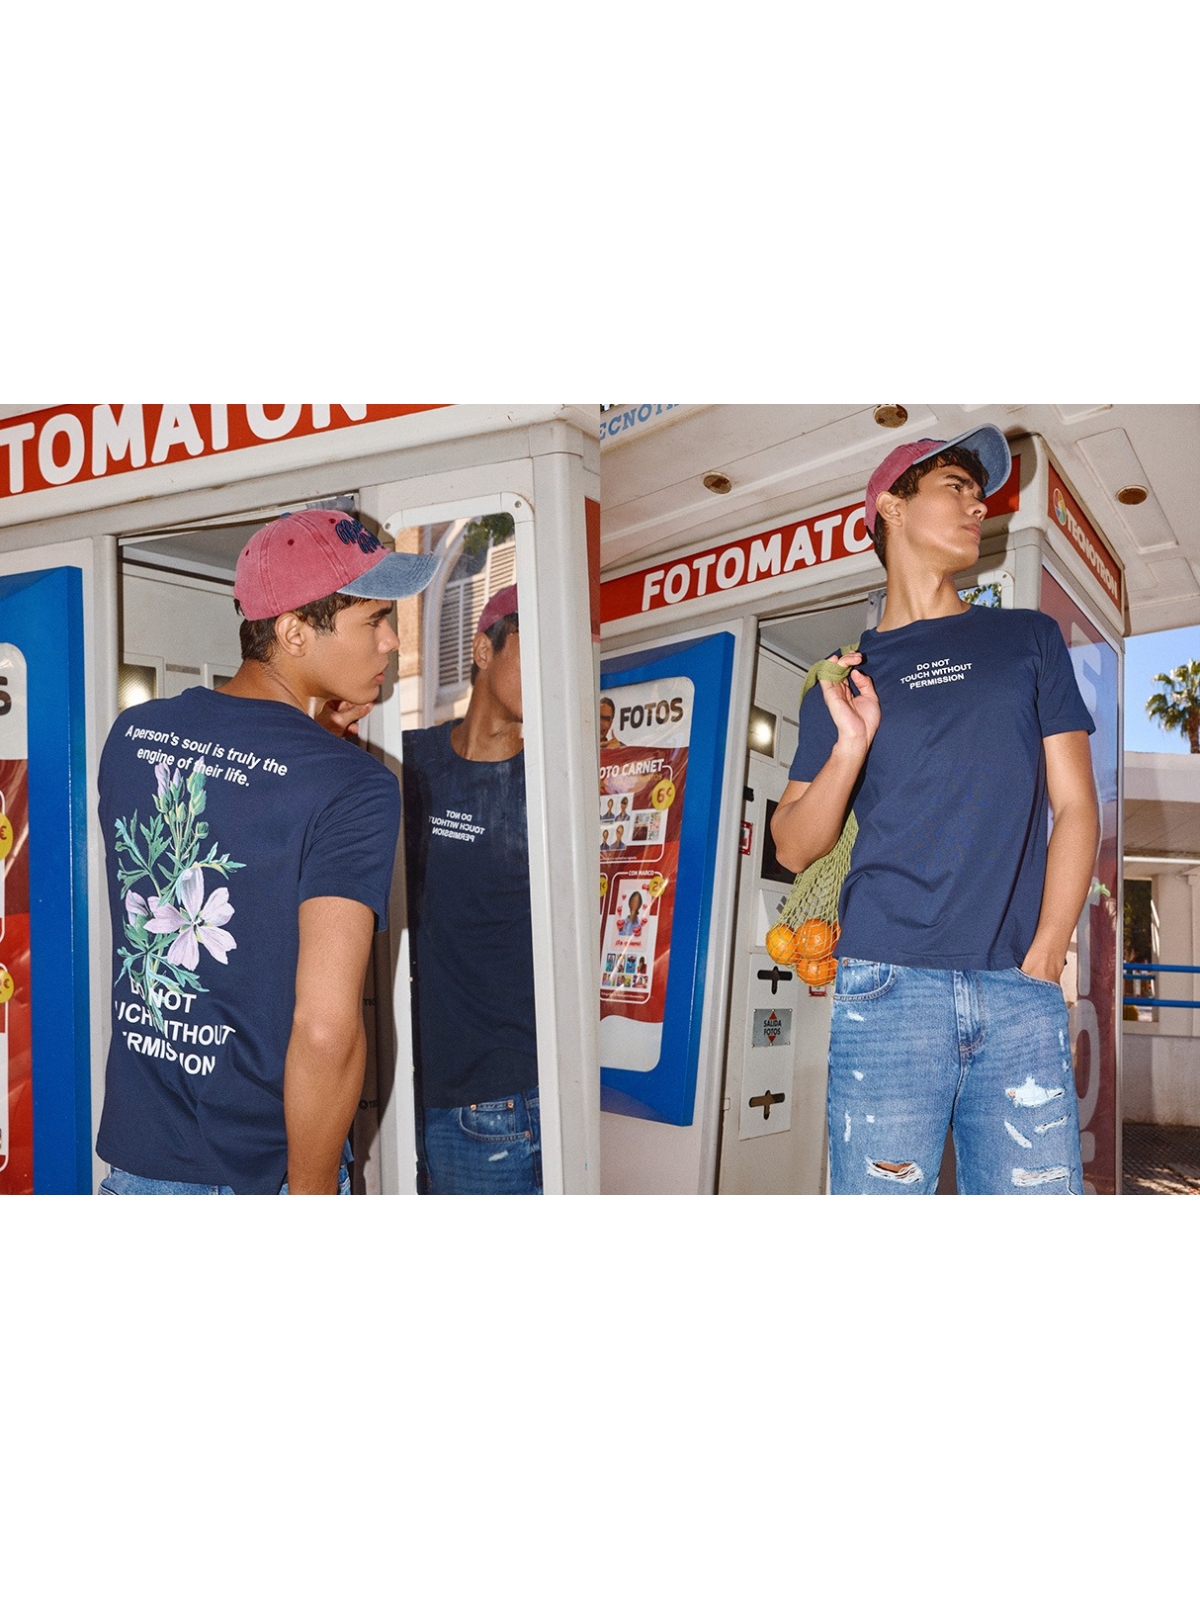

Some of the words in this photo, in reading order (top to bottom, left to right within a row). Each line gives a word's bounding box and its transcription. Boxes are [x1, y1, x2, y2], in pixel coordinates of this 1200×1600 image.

[1065, 507, 1118, 600] TECNOTRON
[900, 671, 930, 684] TOUCH
[931, 663, 972, 676] WITHOUT
[916, 663, 930, 671] DO
[931, 659, 950, 668] NOT
[909, 673, 964, 690] PERMISSION
[620, 697, 684, 731] FOTOS
[125, 725, 134, 737] A
[132, 728, 179, 747] person's
[181, 738, 212, 755] soul
[212, 744, 226, 759] is
[226, 747, 262, 769] truly
[262, 757, 288, 776] the
[136, 747, 175, 767] engine
[176, 756, 193, 770] of
[193, 760, 225, 779] their
[223, 767, 250, 787] life.
[621, 759, 665, 775] CARNET
[763, 1019, 782, 1027] SALIDA
[763, 1028, 781, 1036] FOTOS
